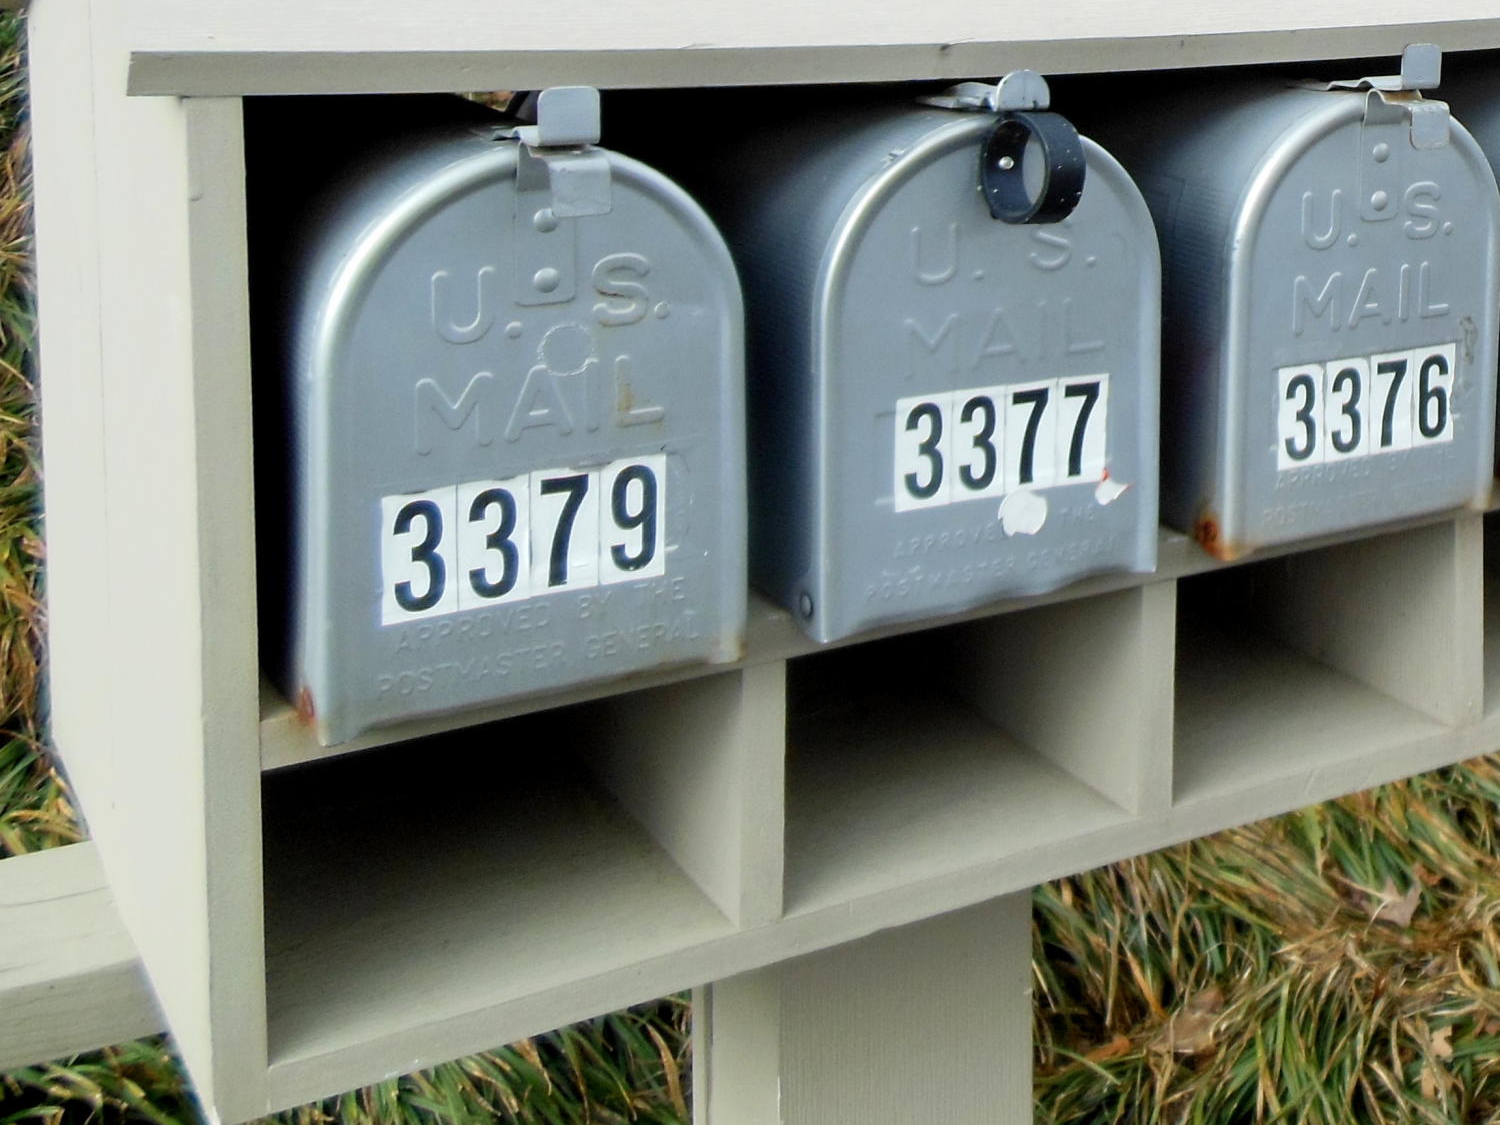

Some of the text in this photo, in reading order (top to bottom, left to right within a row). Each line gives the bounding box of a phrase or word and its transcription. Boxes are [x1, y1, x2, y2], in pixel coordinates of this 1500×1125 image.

[903, 297, 1105, 381] MAIL
[1292, 261, 1450, 336] MAIL
[414, 354, 665, 456] MAIL
[904, 382, 1100, 499] 3377
[1284, 354, 1449, 461] 3376
[393, 464, 659, 613] 3379
[377, 616, 702, 702] POSTMASTER GENERAL
[395, 575, 687, 657] APPROVED BY THE
